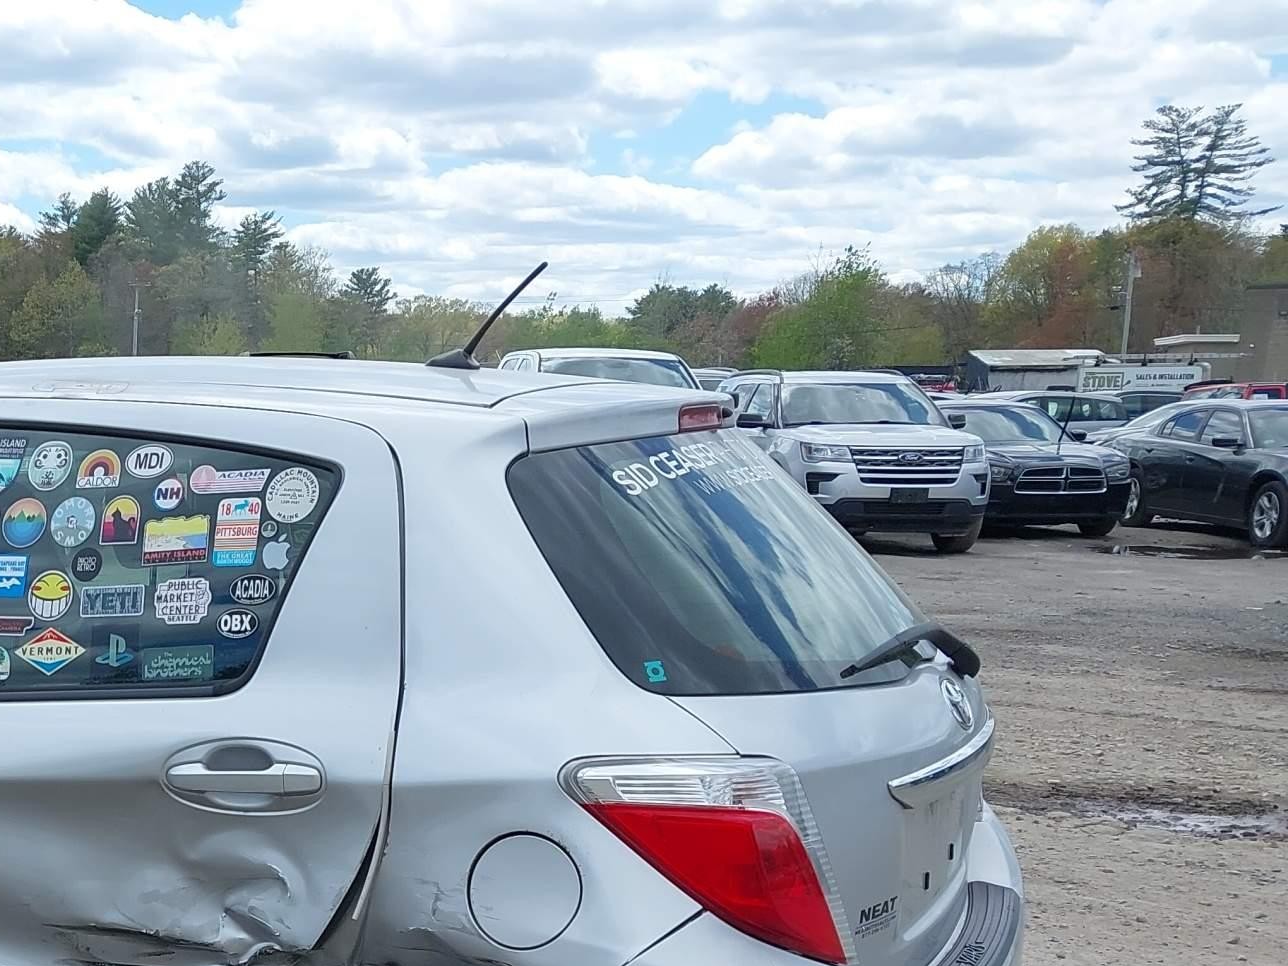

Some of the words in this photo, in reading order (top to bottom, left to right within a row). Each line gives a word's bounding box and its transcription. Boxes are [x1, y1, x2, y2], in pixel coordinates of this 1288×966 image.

[1082, 375, 1121, 388] STOVE
[0, 438, 27, 449] ISLAND
[134, 452, 165, 471] MDI
[218, 470, 266, 480] ACADIA
[612, 462, 659, 496] SID
[648, 443, 725, 480] CEASER
[78, 477, 118, 488] CALDOR
[267, 469, 295, 502] CADILLAC
[296, 469, 317, 504] MOUNTAIN
[156, 487, 182, 501] NH
[221, 503, 232, 516] 18
[248, 502, 261, 515] 40
[276, 512, 299, 520] MAINE
[215, 526, 258, 538] PITTSBURG
[144, 551, 173, 561] AMITY
[173, 549, 206, 559] ISLAND
[167, 580, 203, 592] PUBLIC
[235, 579, 270, 599] ACADIA
[85, 590, 139, 612] YETI
[156, 593, 196, 604] MARKET
[161, 604, 201, 615] CENTER
[166, 615, 198, 623] SEATTLE
[220, 614, 252, 633] OBX
[21, 645, 80, 657] VERMONT
[151, 652, 211, 670] chemical
[144, 664, 203, 679] brothers
[859, 895, 898, 925] NEAT
